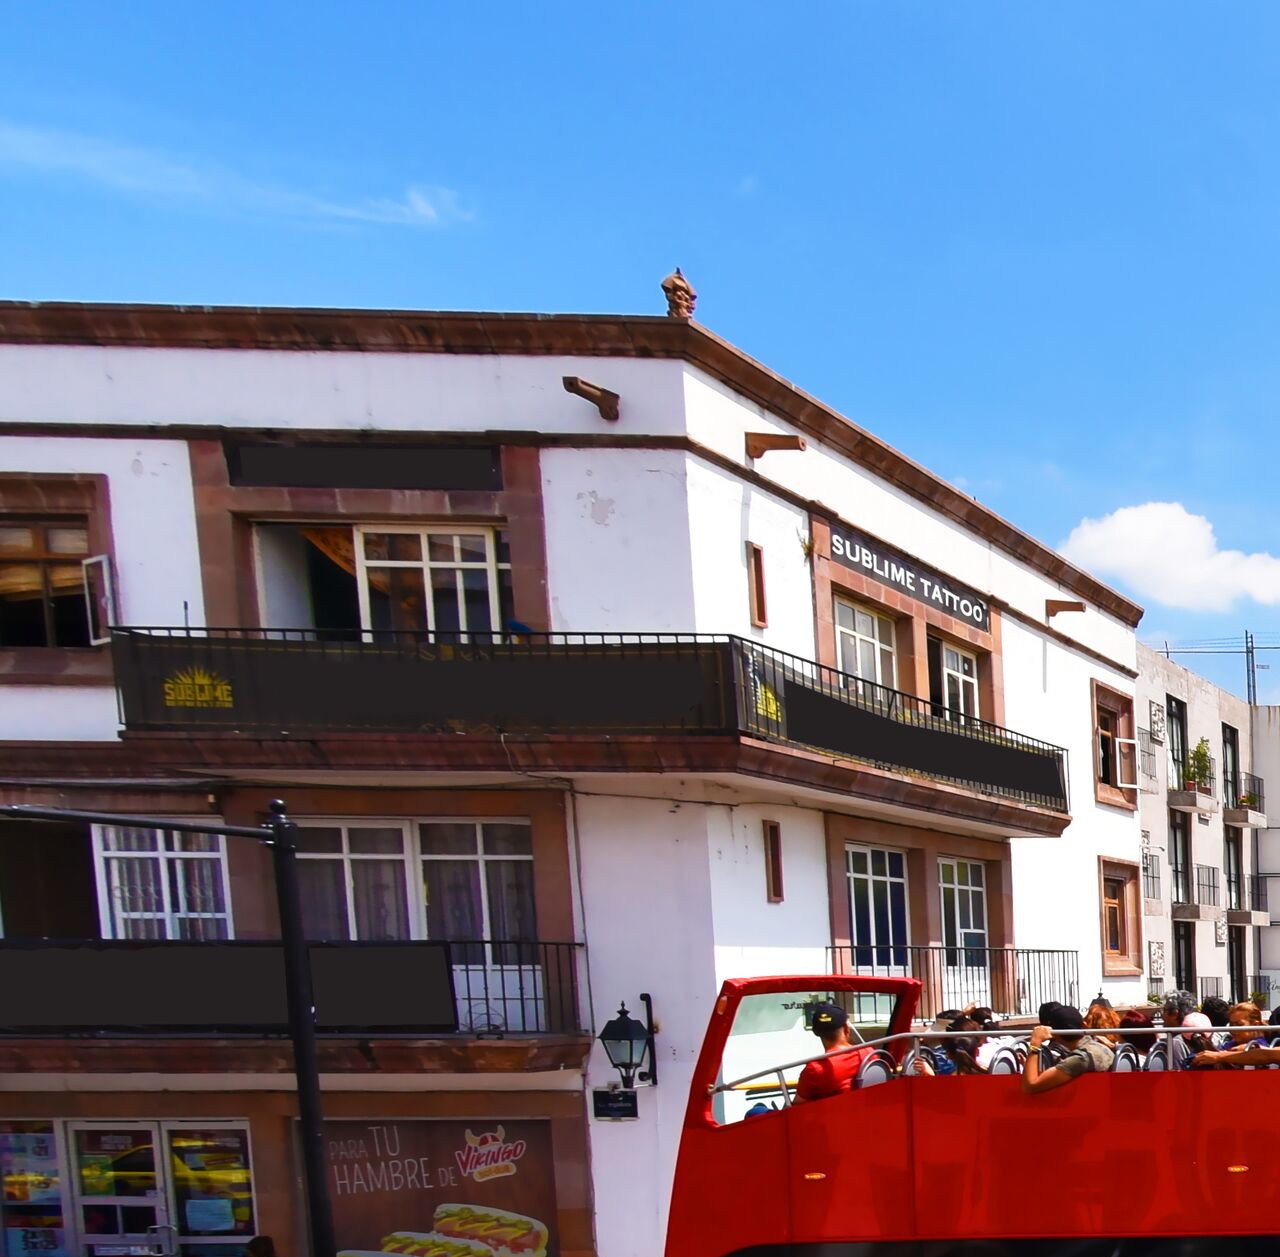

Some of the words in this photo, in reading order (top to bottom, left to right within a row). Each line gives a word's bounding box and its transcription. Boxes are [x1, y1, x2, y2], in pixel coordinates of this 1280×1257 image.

[831, 534, 917, 593] SUBLIME
[919, 576, 984, 623] TATTOO
[329, 1140, 368, 1158] PARA
[368, 1125, 401, 1158] TU
[334, 1158, 435, 1195] HAMBRE
[438, 1166, 459, 1188] DE
